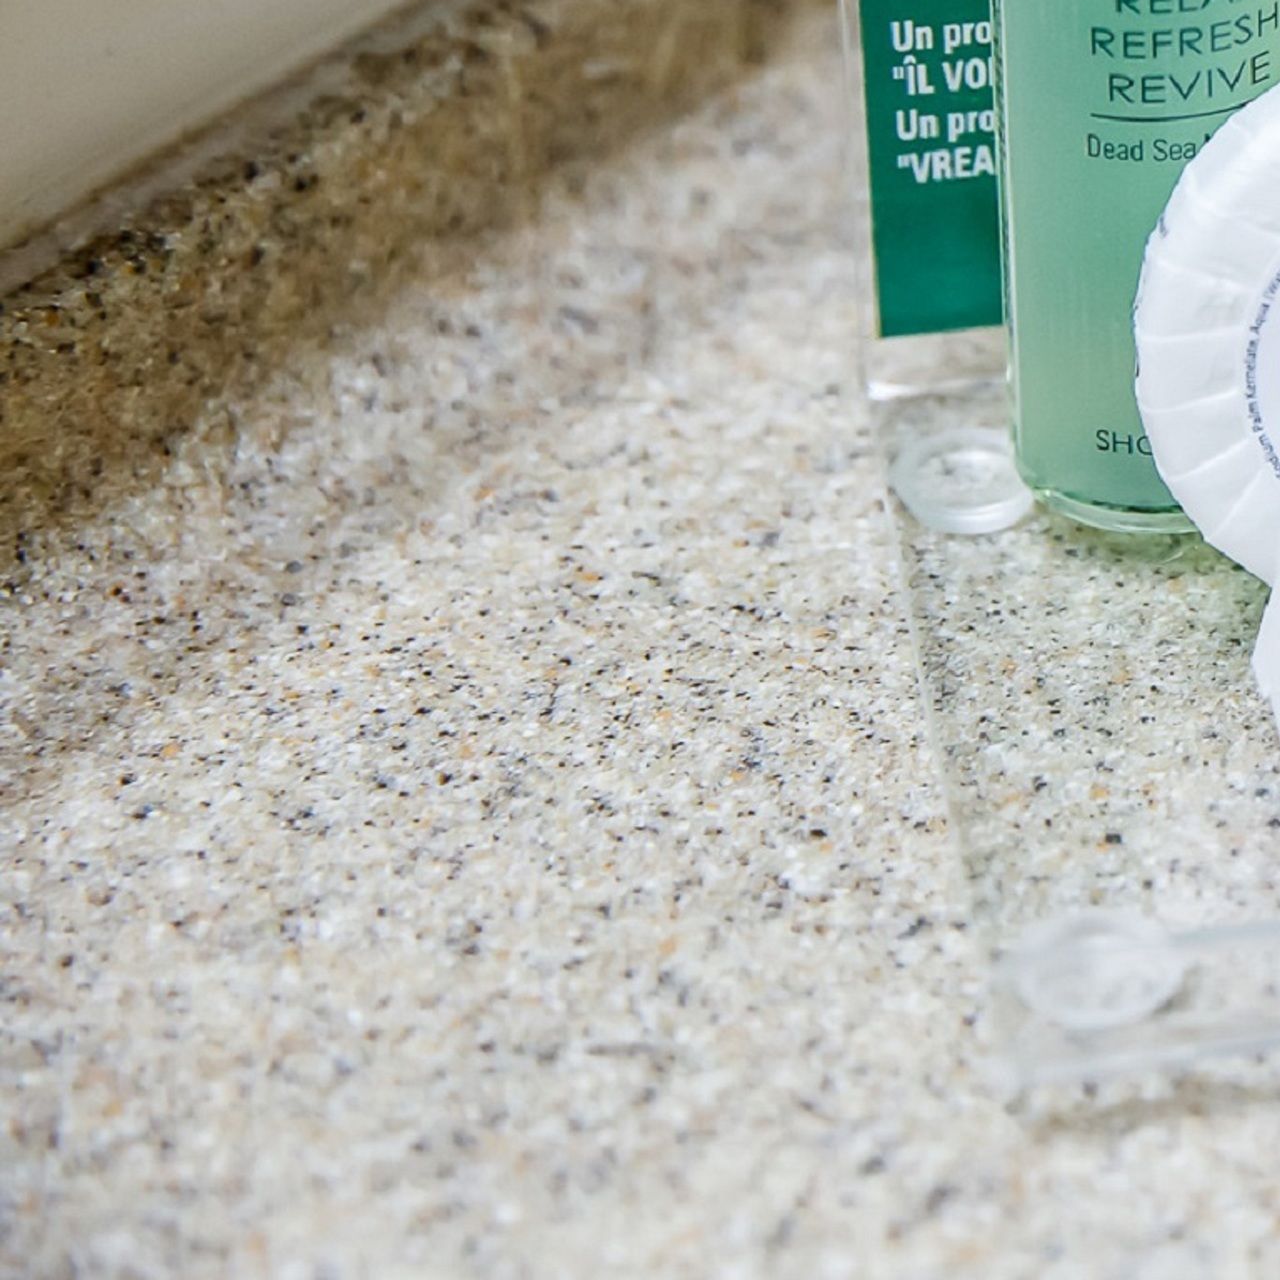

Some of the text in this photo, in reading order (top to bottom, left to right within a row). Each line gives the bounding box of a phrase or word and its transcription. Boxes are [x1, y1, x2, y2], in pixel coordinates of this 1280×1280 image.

[890, 20, 934, 52] Un
[1091, 1, 1279, 60] REFRESH
[1108, 50, 1271, 104] REVIVE
[896, 108, 940, 141] Un
[1087, 133, 1197, 162] Dead Sea
